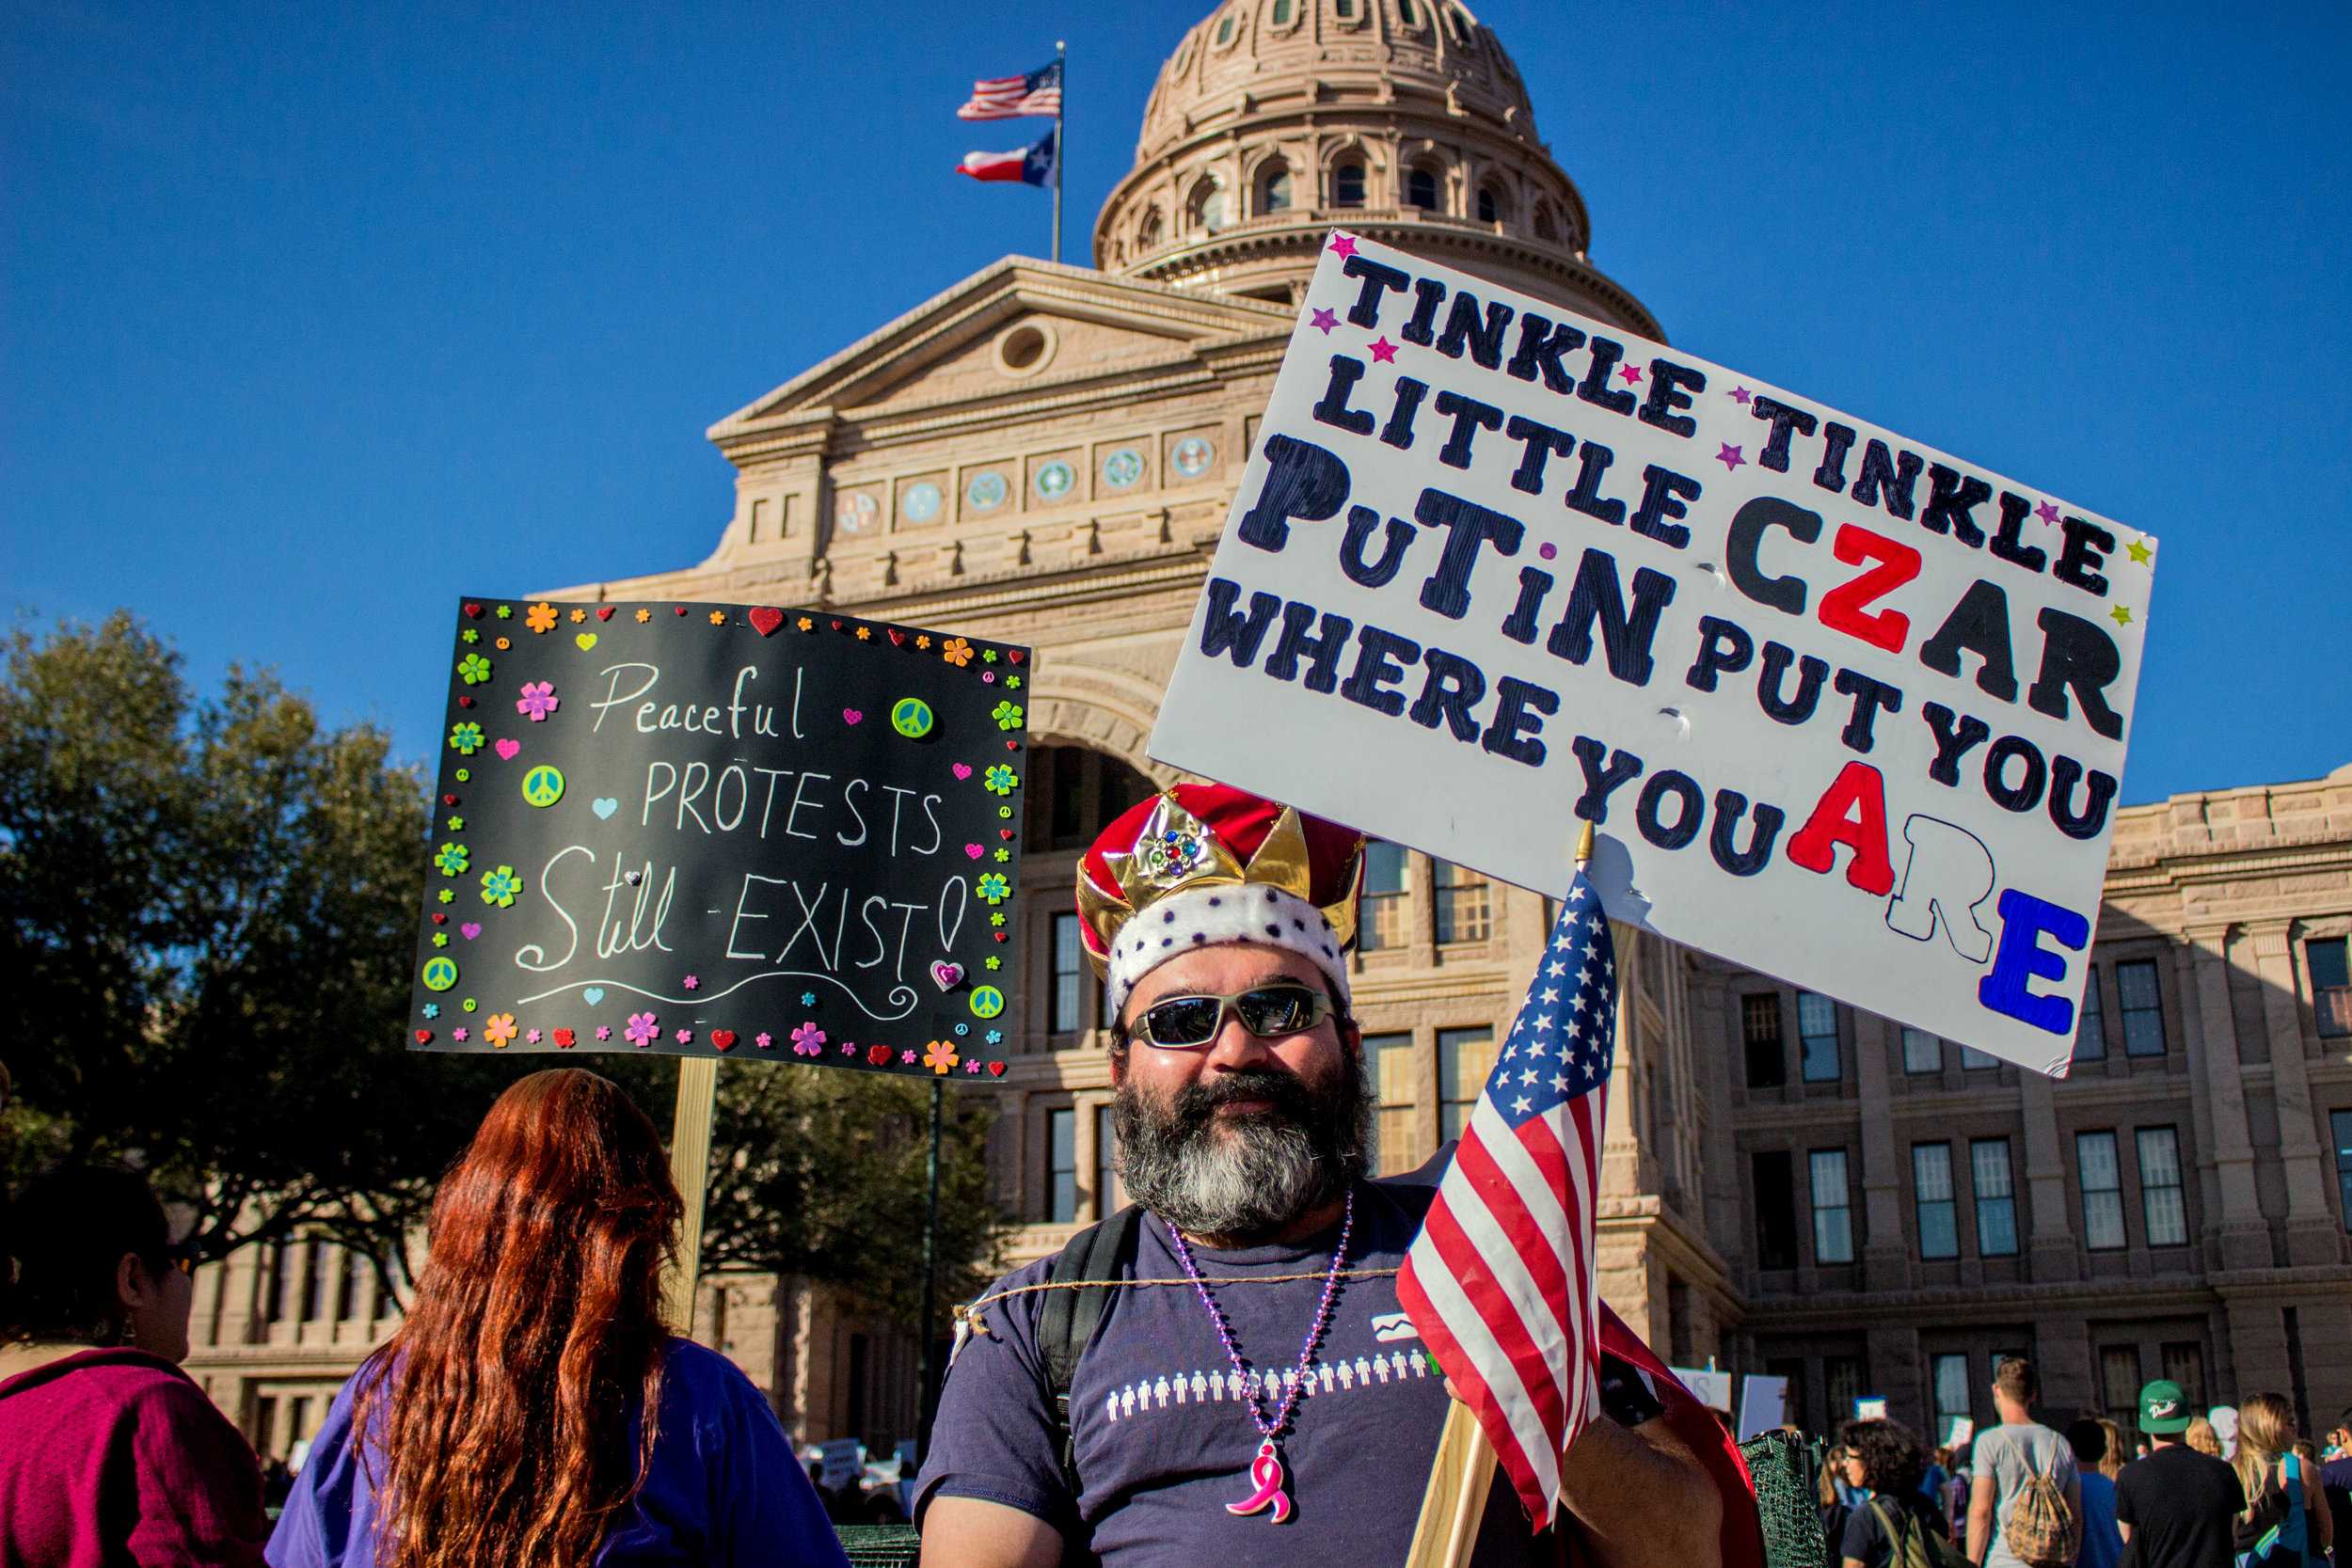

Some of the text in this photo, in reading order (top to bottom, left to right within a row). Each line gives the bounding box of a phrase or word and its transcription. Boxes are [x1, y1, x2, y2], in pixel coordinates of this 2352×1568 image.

[1343, 255, 2115, 597] TINKLE TINKLE
[1312, 354, 2123, 741] LITTLE CZAR
[591, 662, 803, 738] Peaceful
[642, 762, 942, 857] PROTESTS
[1200, 577, 2090, 1036] WHERE YOU ARE
[1686, 615, 1902, 753] PUT
[1922, 701, 2117, 840] YOU
[516, 846, 676, 972] Still
